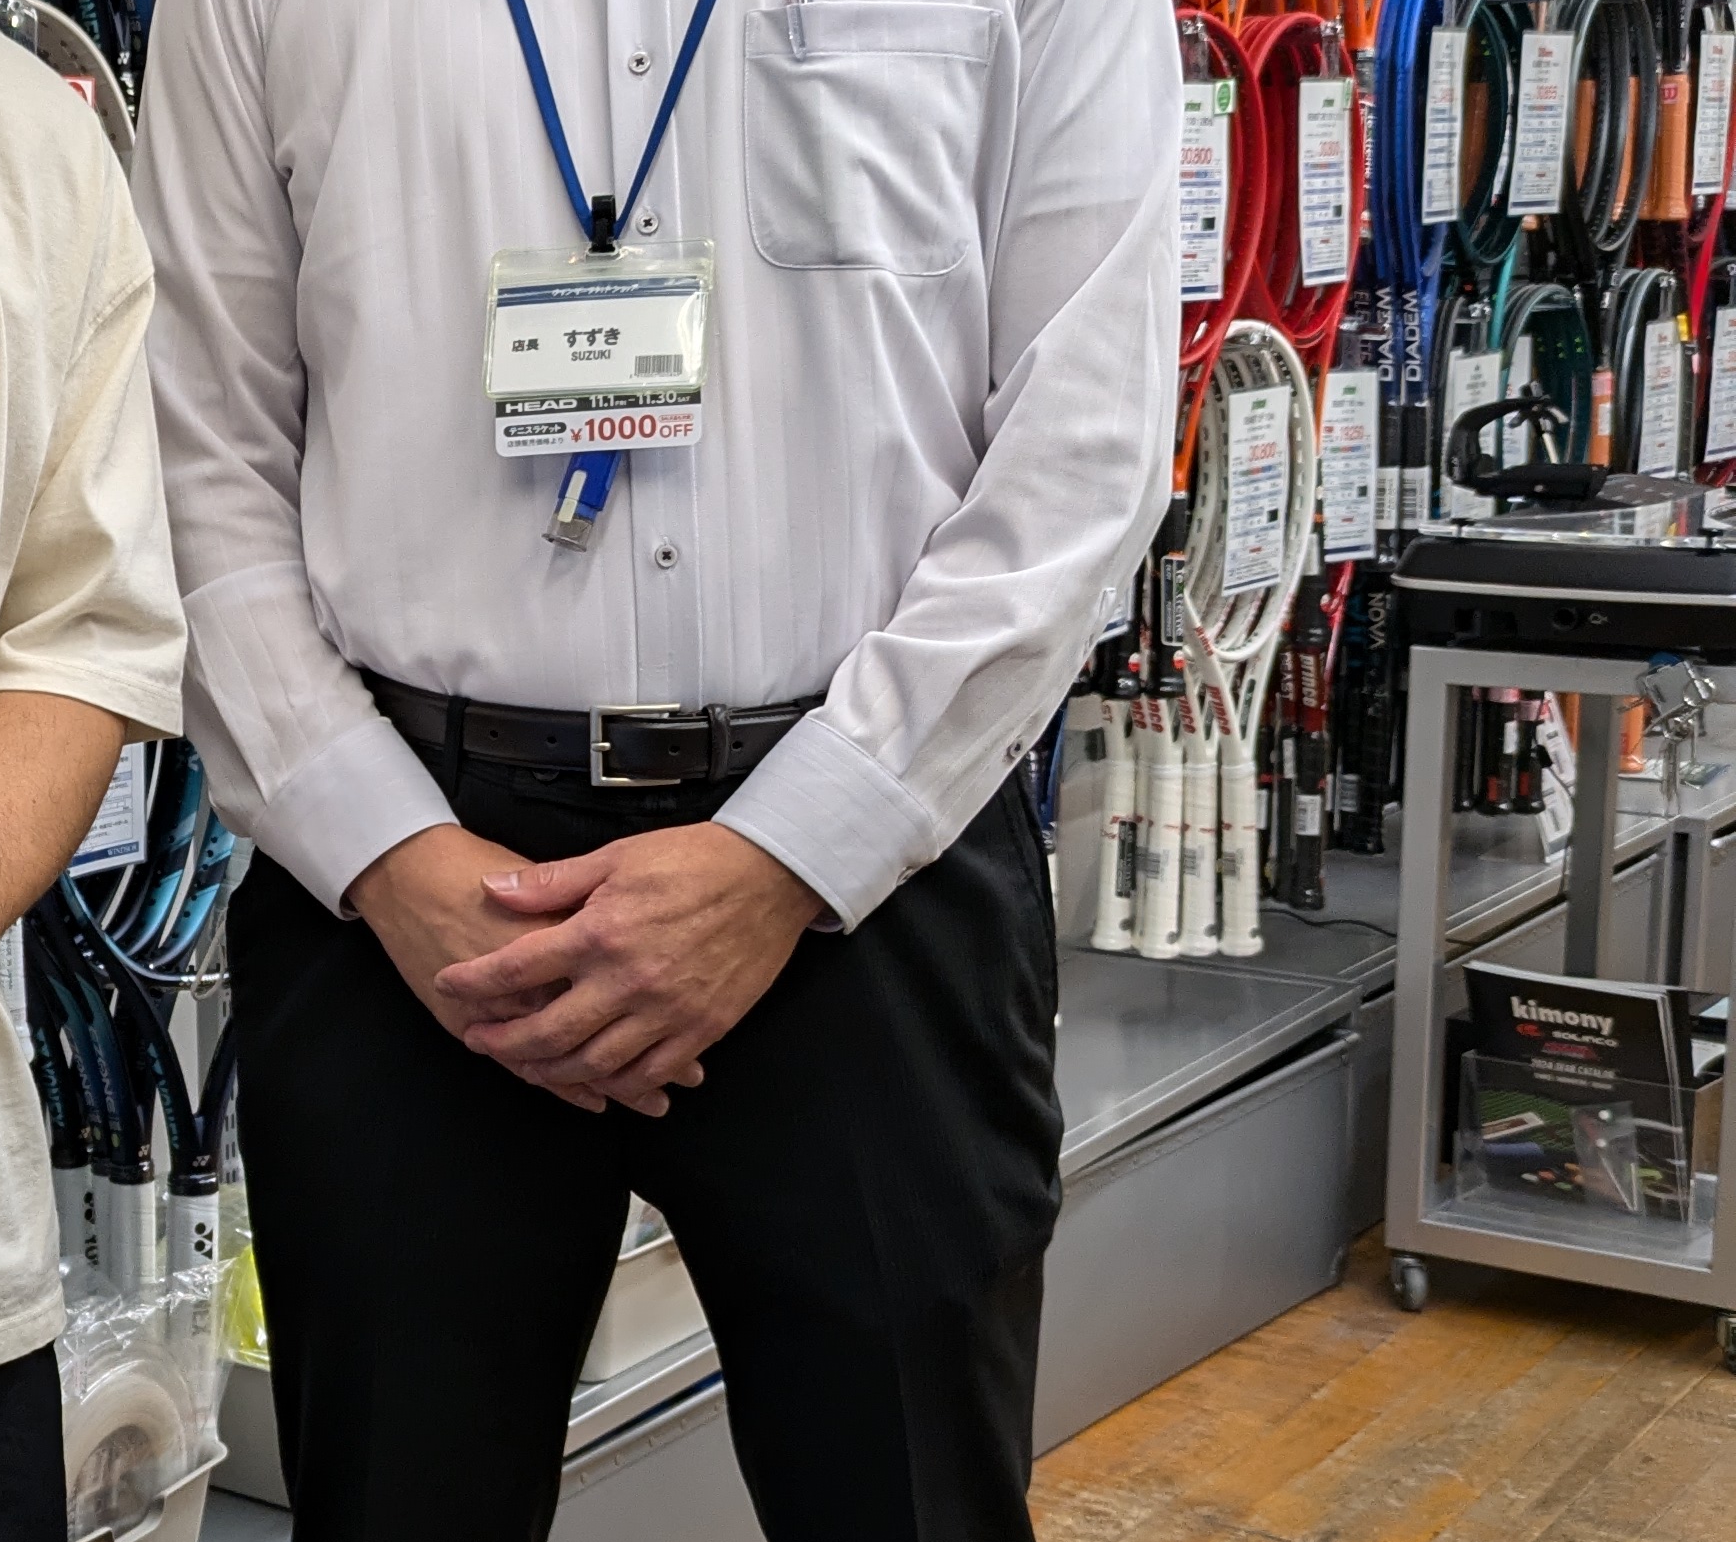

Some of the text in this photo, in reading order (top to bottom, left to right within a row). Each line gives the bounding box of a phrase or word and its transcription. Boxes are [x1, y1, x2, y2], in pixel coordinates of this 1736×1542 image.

[512, 327, 621, 353] 店長 すずき
[1402, 289, 1423, 382] DIADEM
[571, 349, 611, 362] SUZUKI
[505, 398, 578, 414] HEAD
[508, 425, 562, 436] テニスラケット
[570, 414, 694, 444] ¥1000 OFF
[1510, 995, 1614, 1037] kimony
